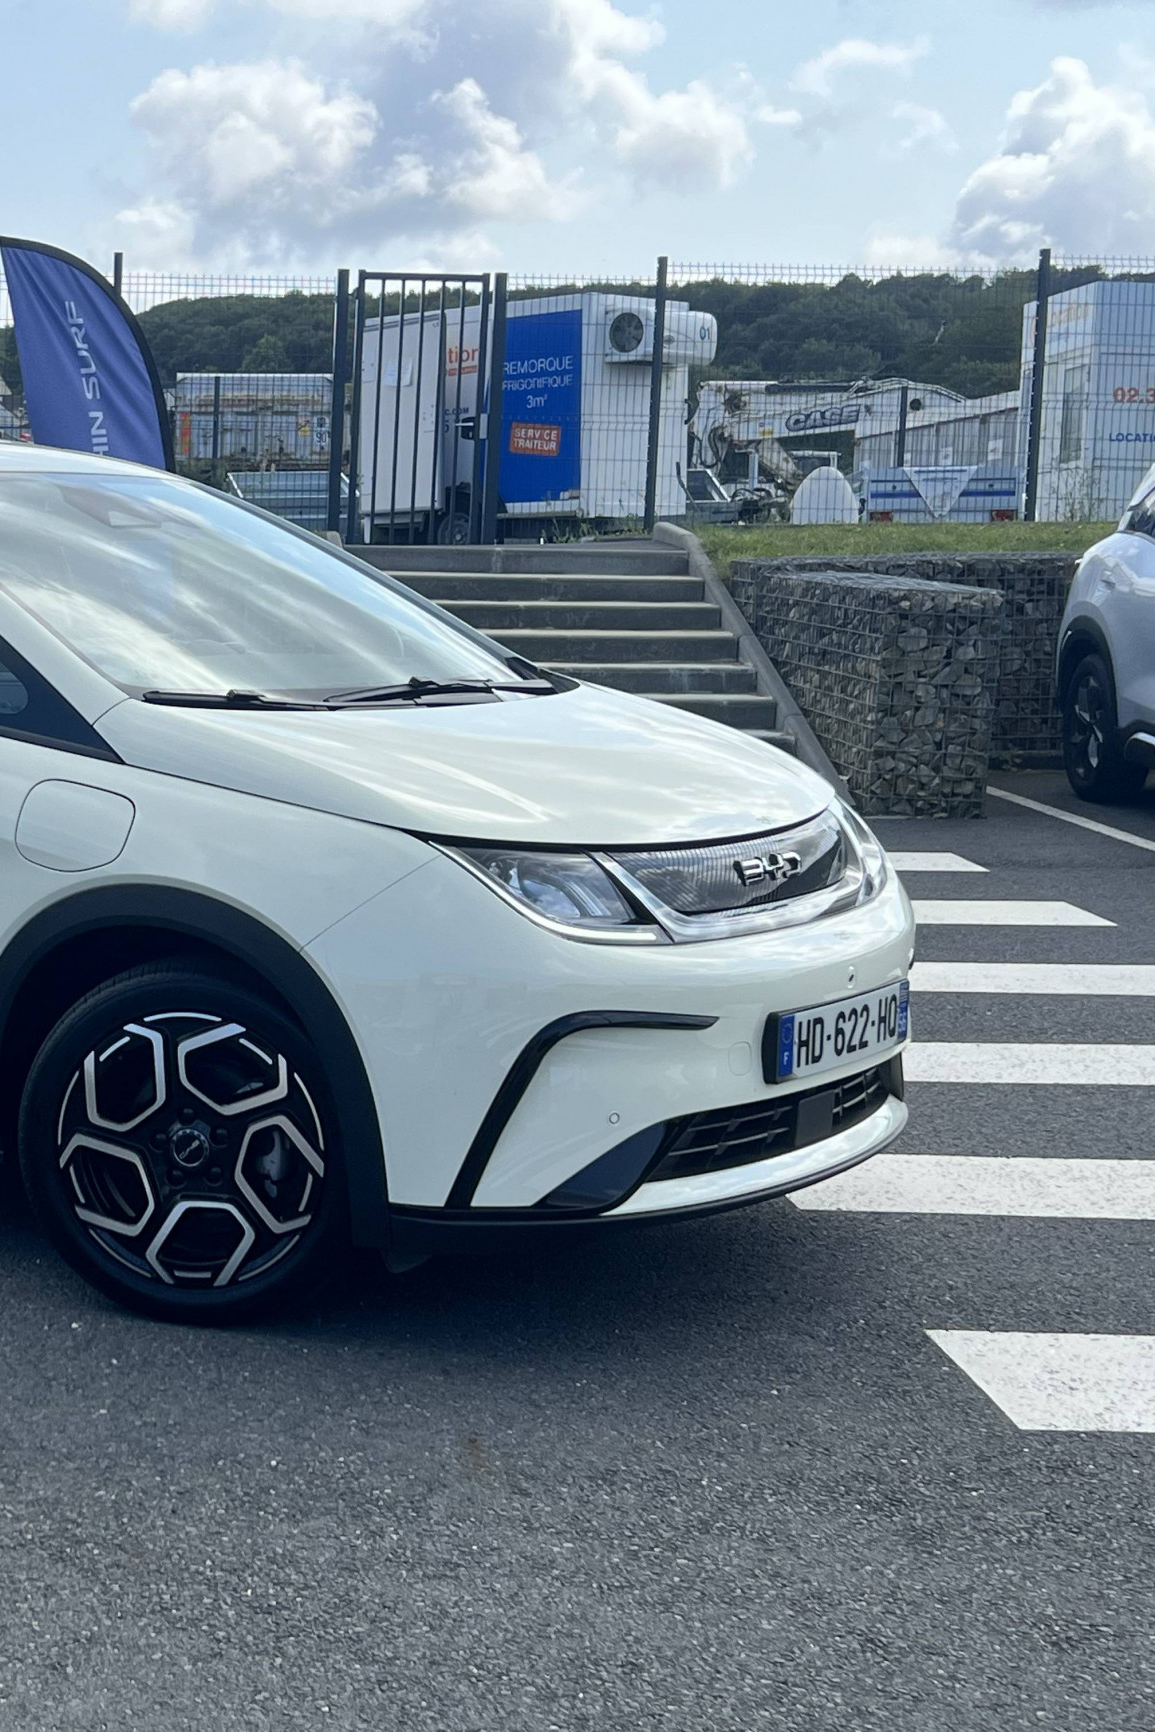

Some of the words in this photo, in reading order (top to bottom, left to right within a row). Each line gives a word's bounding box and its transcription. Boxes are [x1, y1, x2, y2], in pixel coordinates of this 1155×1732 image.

[65, 301, 101, 399] SURF
[503, 356, 574, 376] REMORQUE
[502, 374, 574, 391] FRIGORIFIQUE
[786, 404, 862, 432] CASE
[514, 427, 558, 441] SERVICE
[1109, 432, 1155, 443] LOCATI
[513, 438, 557, 452] TRAITEUR
[733, 851, 802, 887] BYD
[797, 993, 898, 1068] HD-622-HQ
